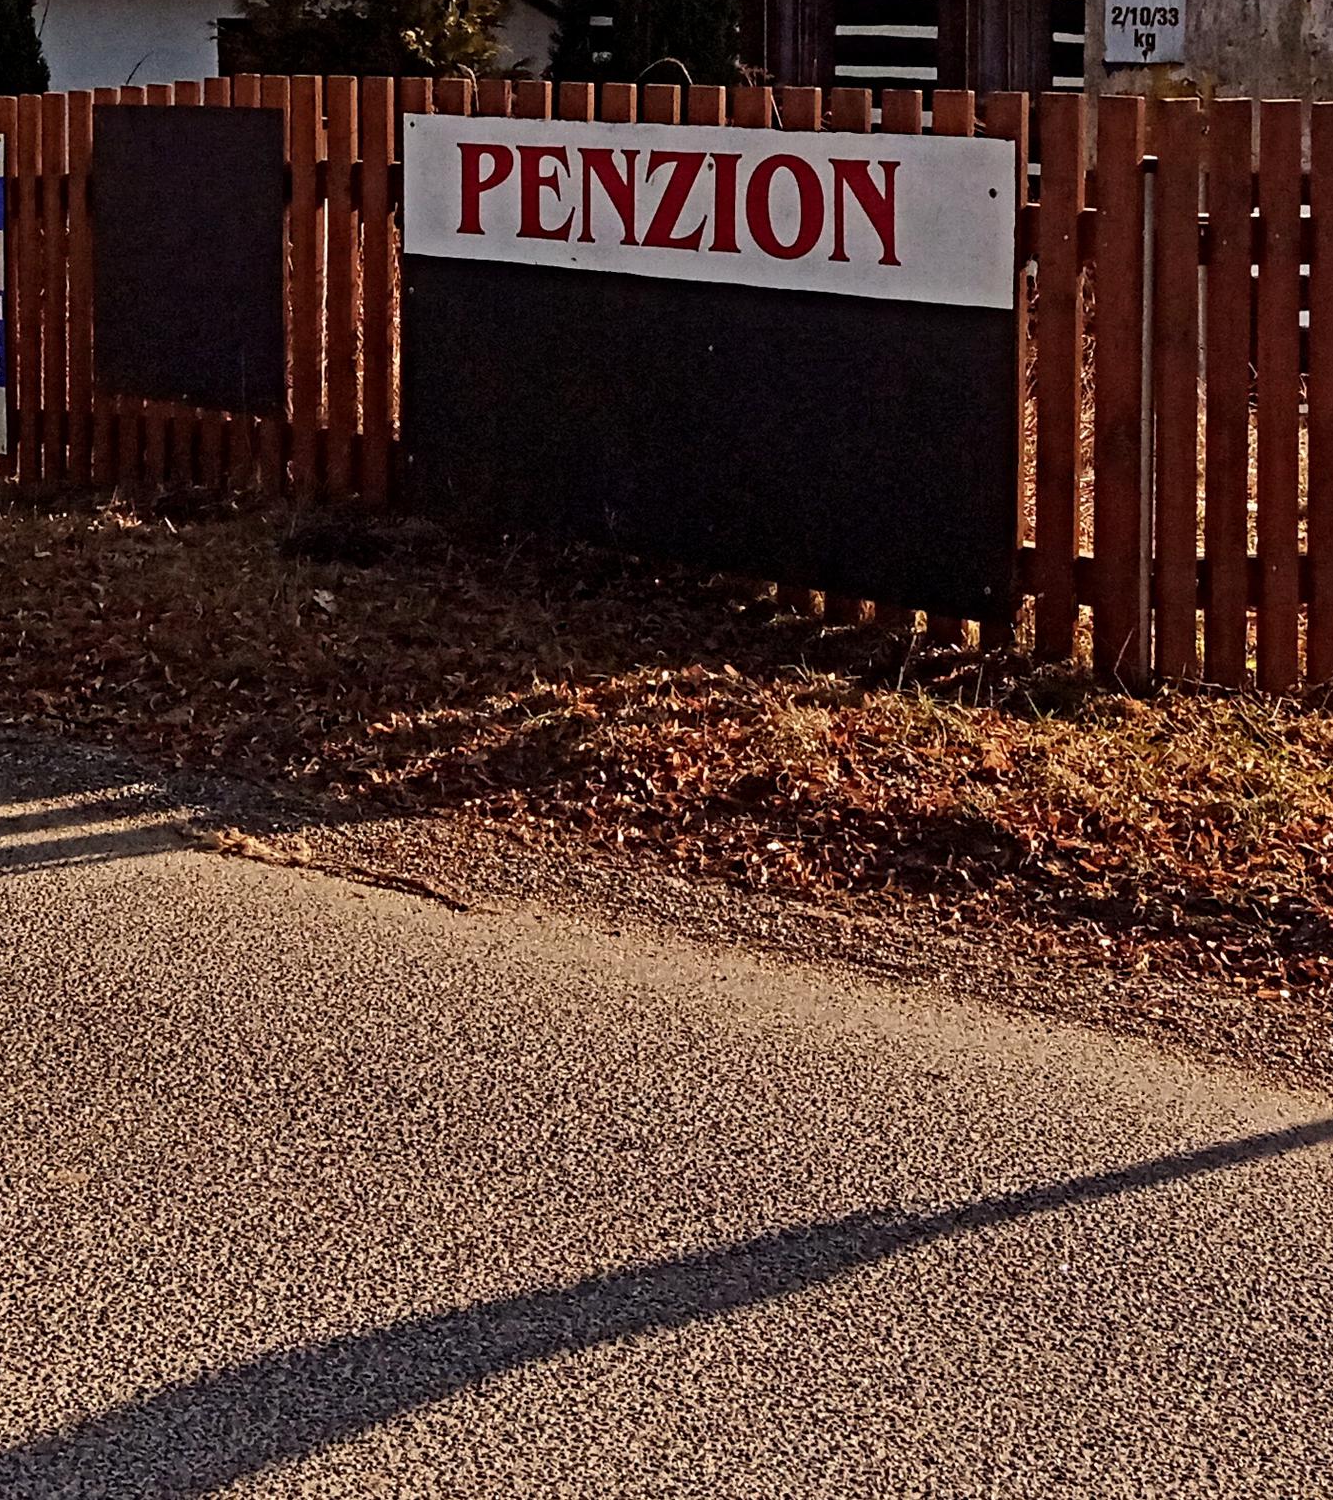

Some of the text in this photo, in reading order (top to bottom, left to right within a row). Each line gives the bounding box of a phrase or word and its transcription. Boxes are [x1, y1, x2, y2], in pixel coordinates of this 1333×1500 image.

[1111, 6, 1180, 27] 2/10/33
[1133, 29, 1156, 51] kg
[456, 141, 902, 267] PENZION
